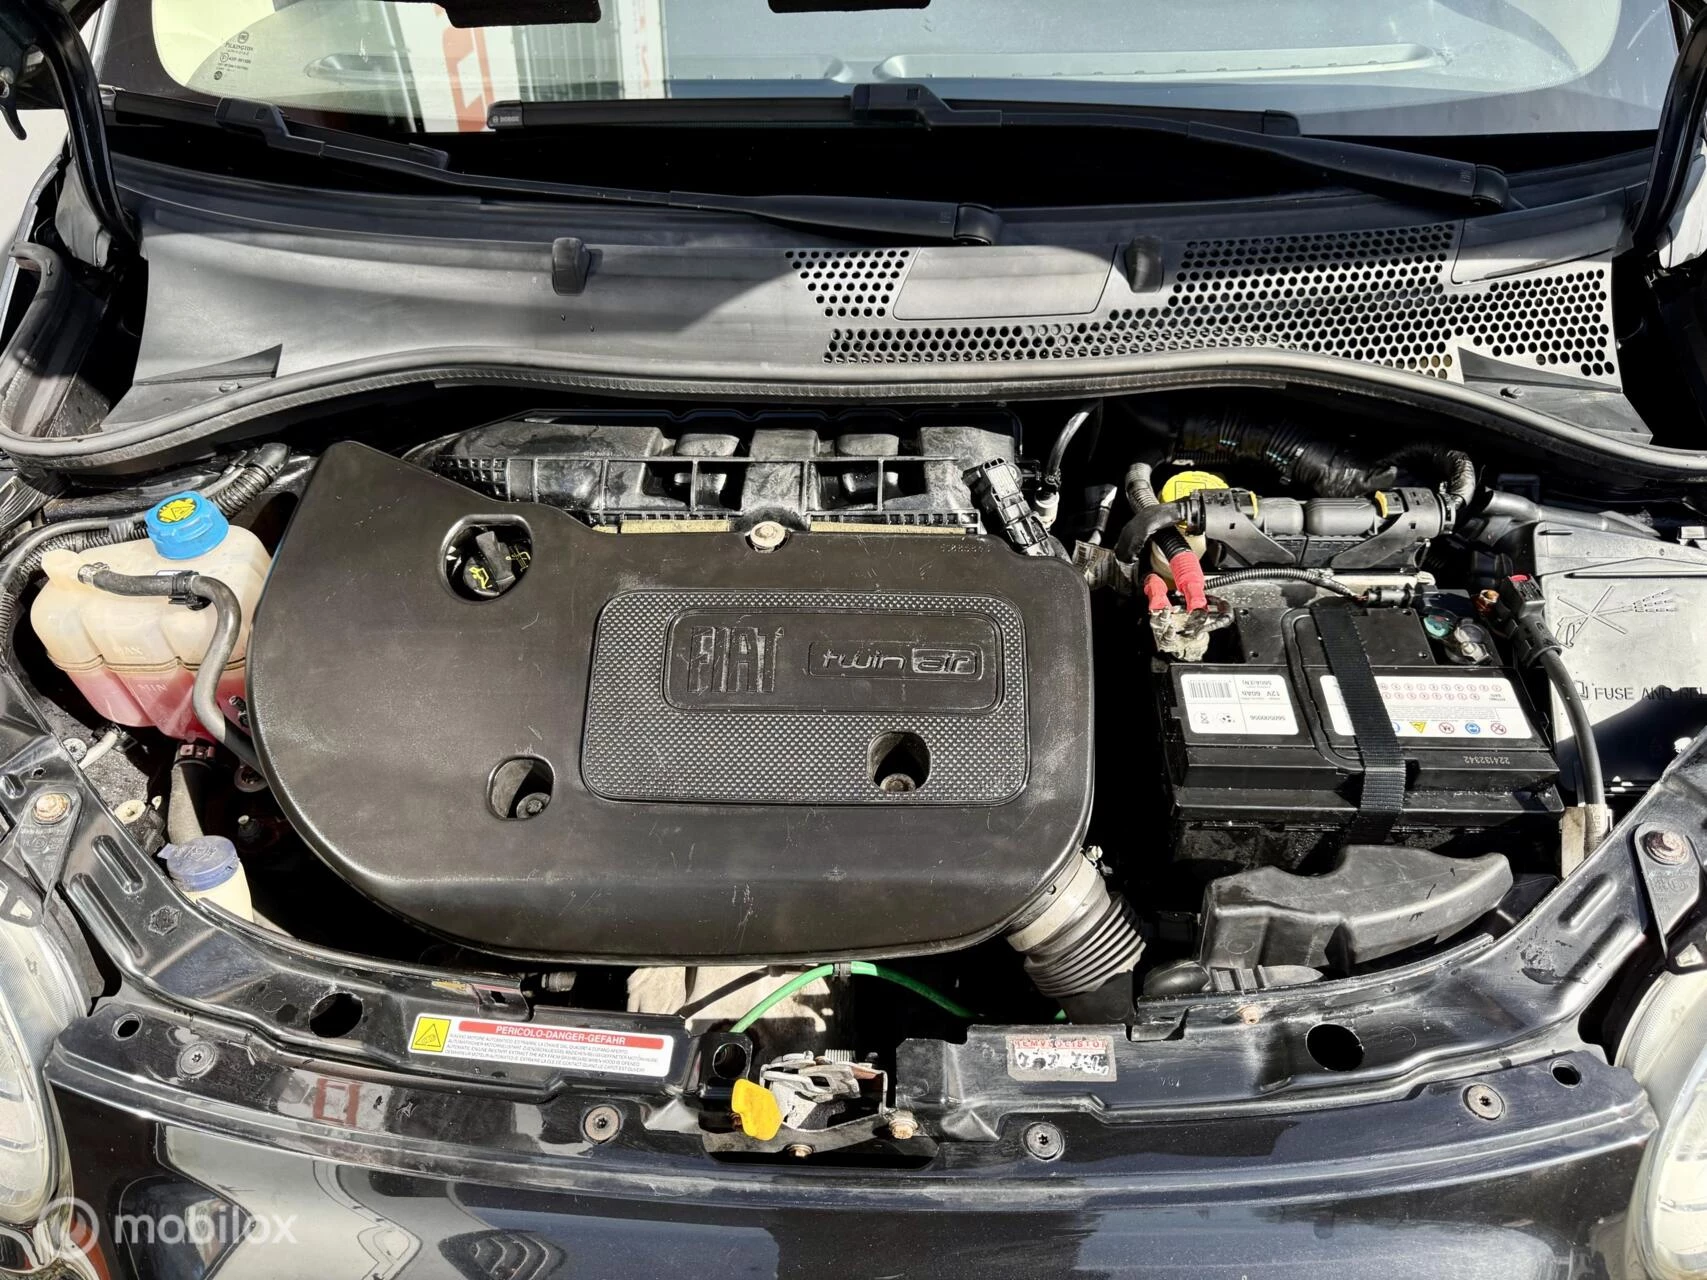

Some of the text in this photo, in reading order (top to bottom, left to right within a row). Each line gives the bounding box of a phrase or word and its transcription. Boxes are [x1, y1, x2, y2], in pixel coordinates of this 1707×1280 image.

[687, 626, 784, 693] FIAT
[1594, 687, 1635, 700] FUSE
[495, 1025, 627, 1046] PERICOLO-DANGER-GEFAHR
